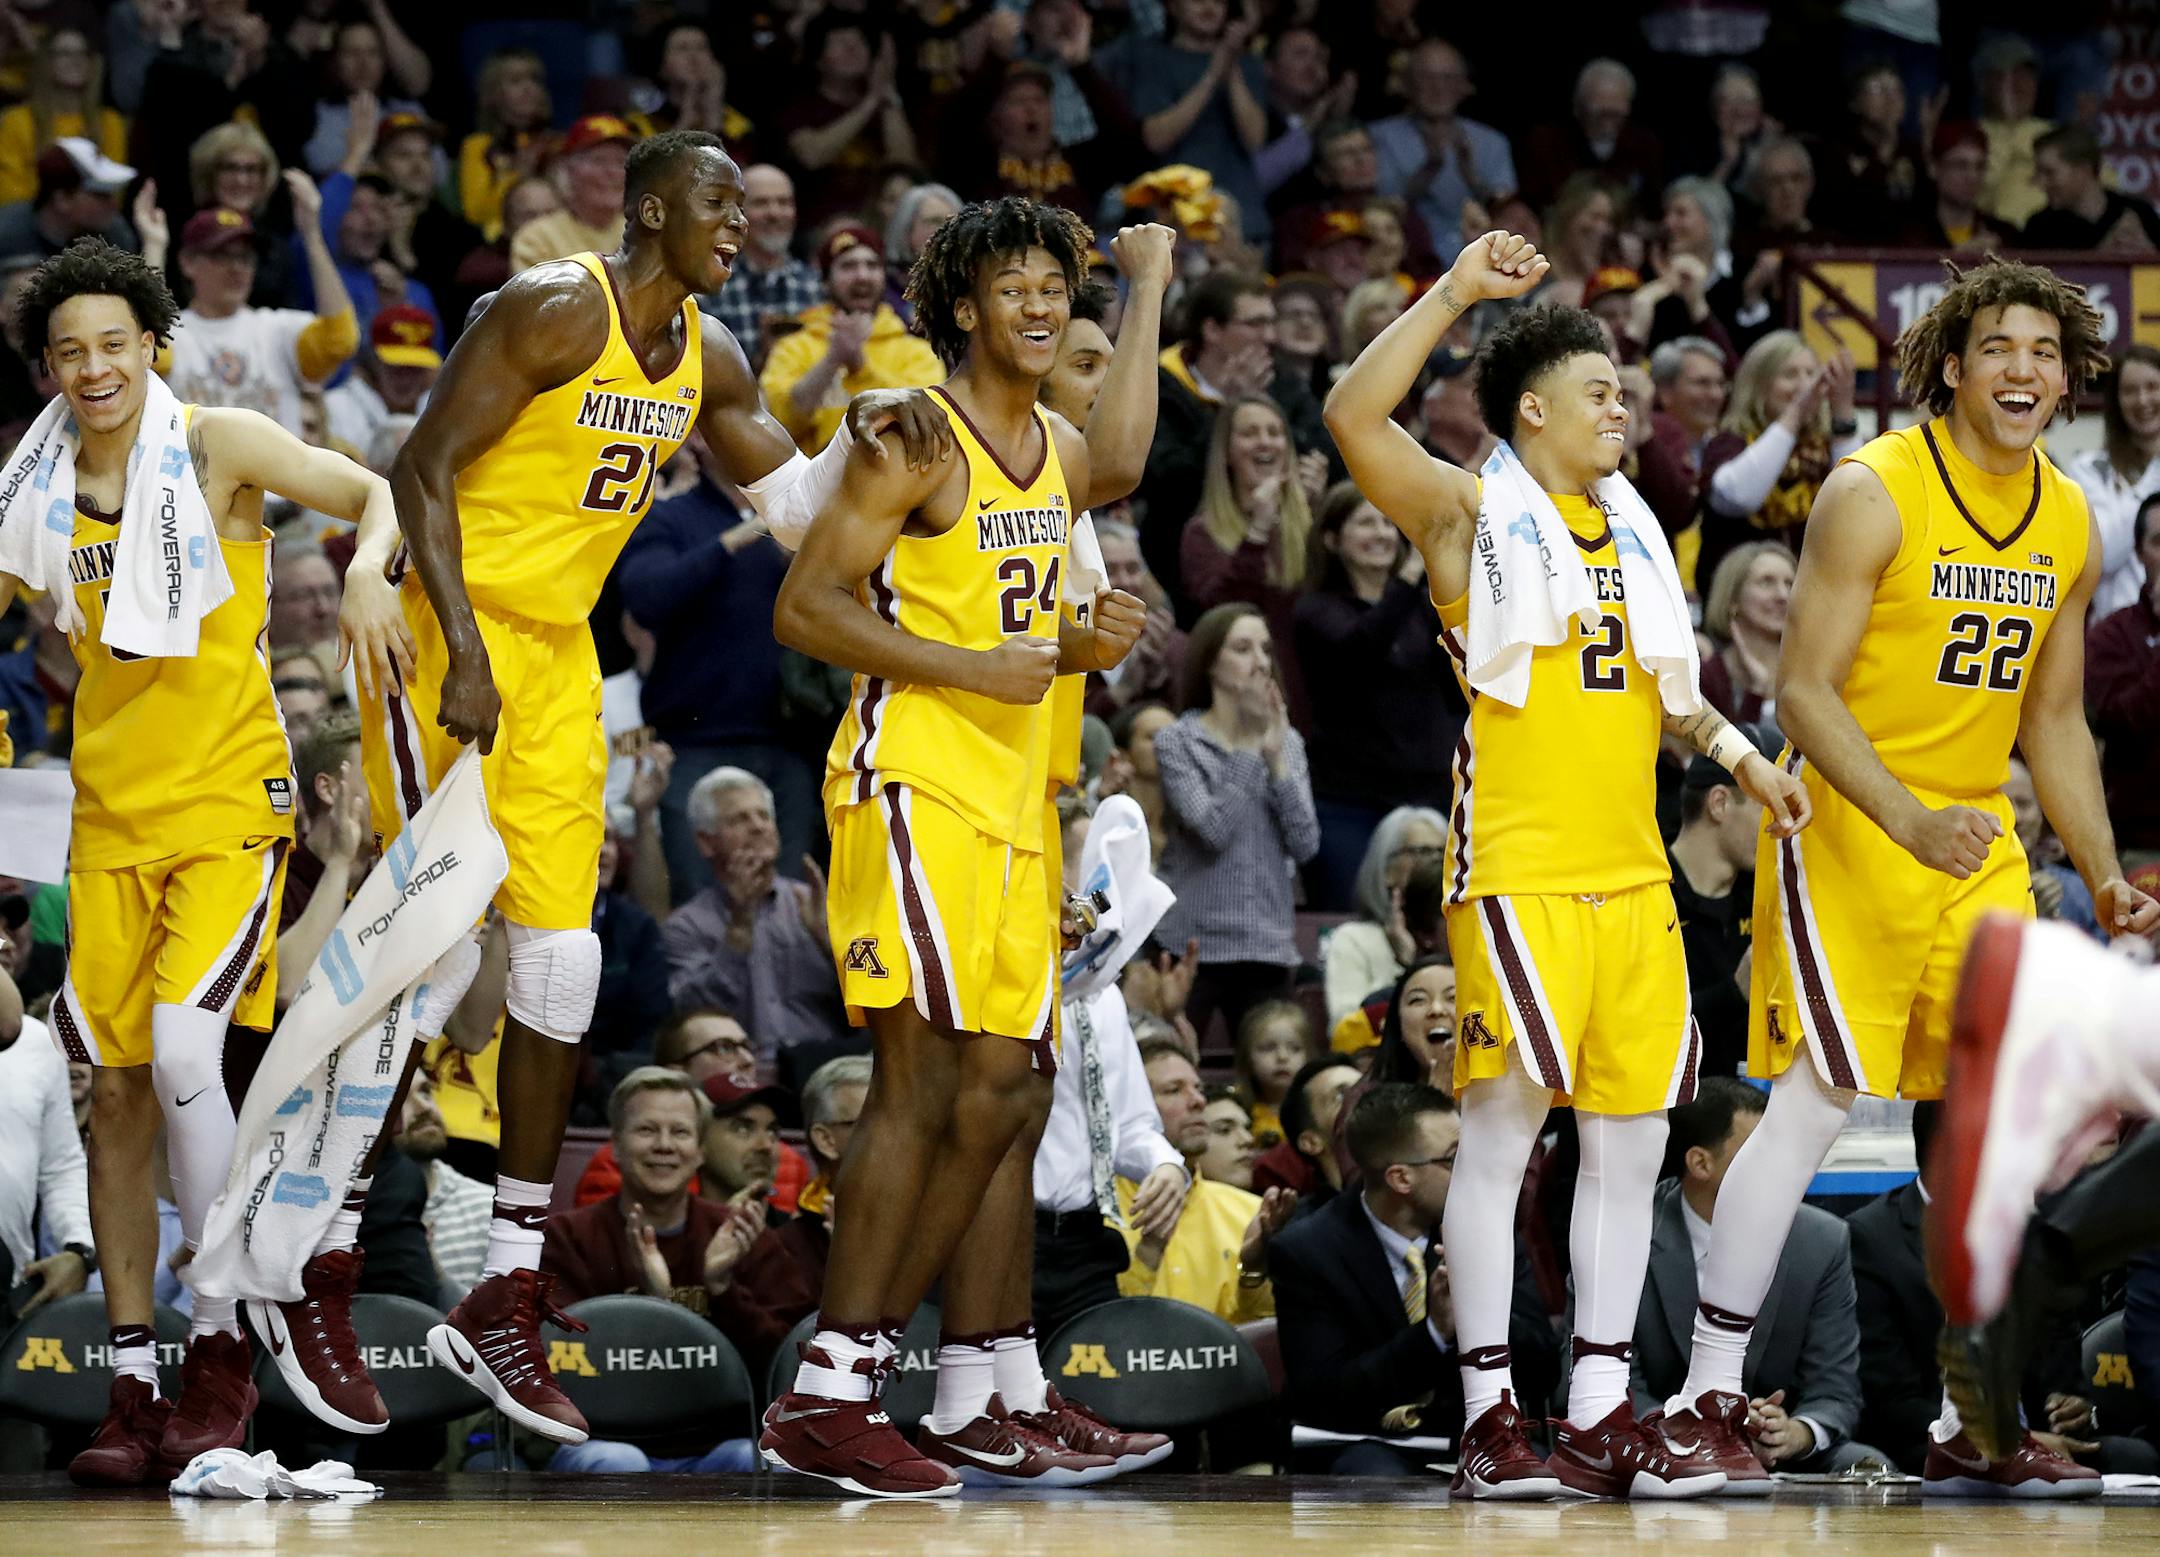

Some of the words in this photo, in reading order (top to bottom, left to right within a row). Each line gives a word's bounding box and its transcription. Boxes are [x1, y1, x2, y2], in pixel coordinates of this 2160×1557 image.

[576, 390, 693, 442] MINNESOTA
[579, 441, 659, 515] 21
[975, 508, 1069, 552] MINNESOTA
[996, 555, 1060, 635] 24
[1930, 561, 2057, 612] MINNESOTA
[1578, 612, 1627, 693] 2
[1935, 611, 2035, 693] 22
[271, 780, 286, 790] 48
[357, 851, 459, 946] PORADE
[606, 1345, 718, 1371] HEALTH
[1126, 1344, 1238, 1372] HEALTH
